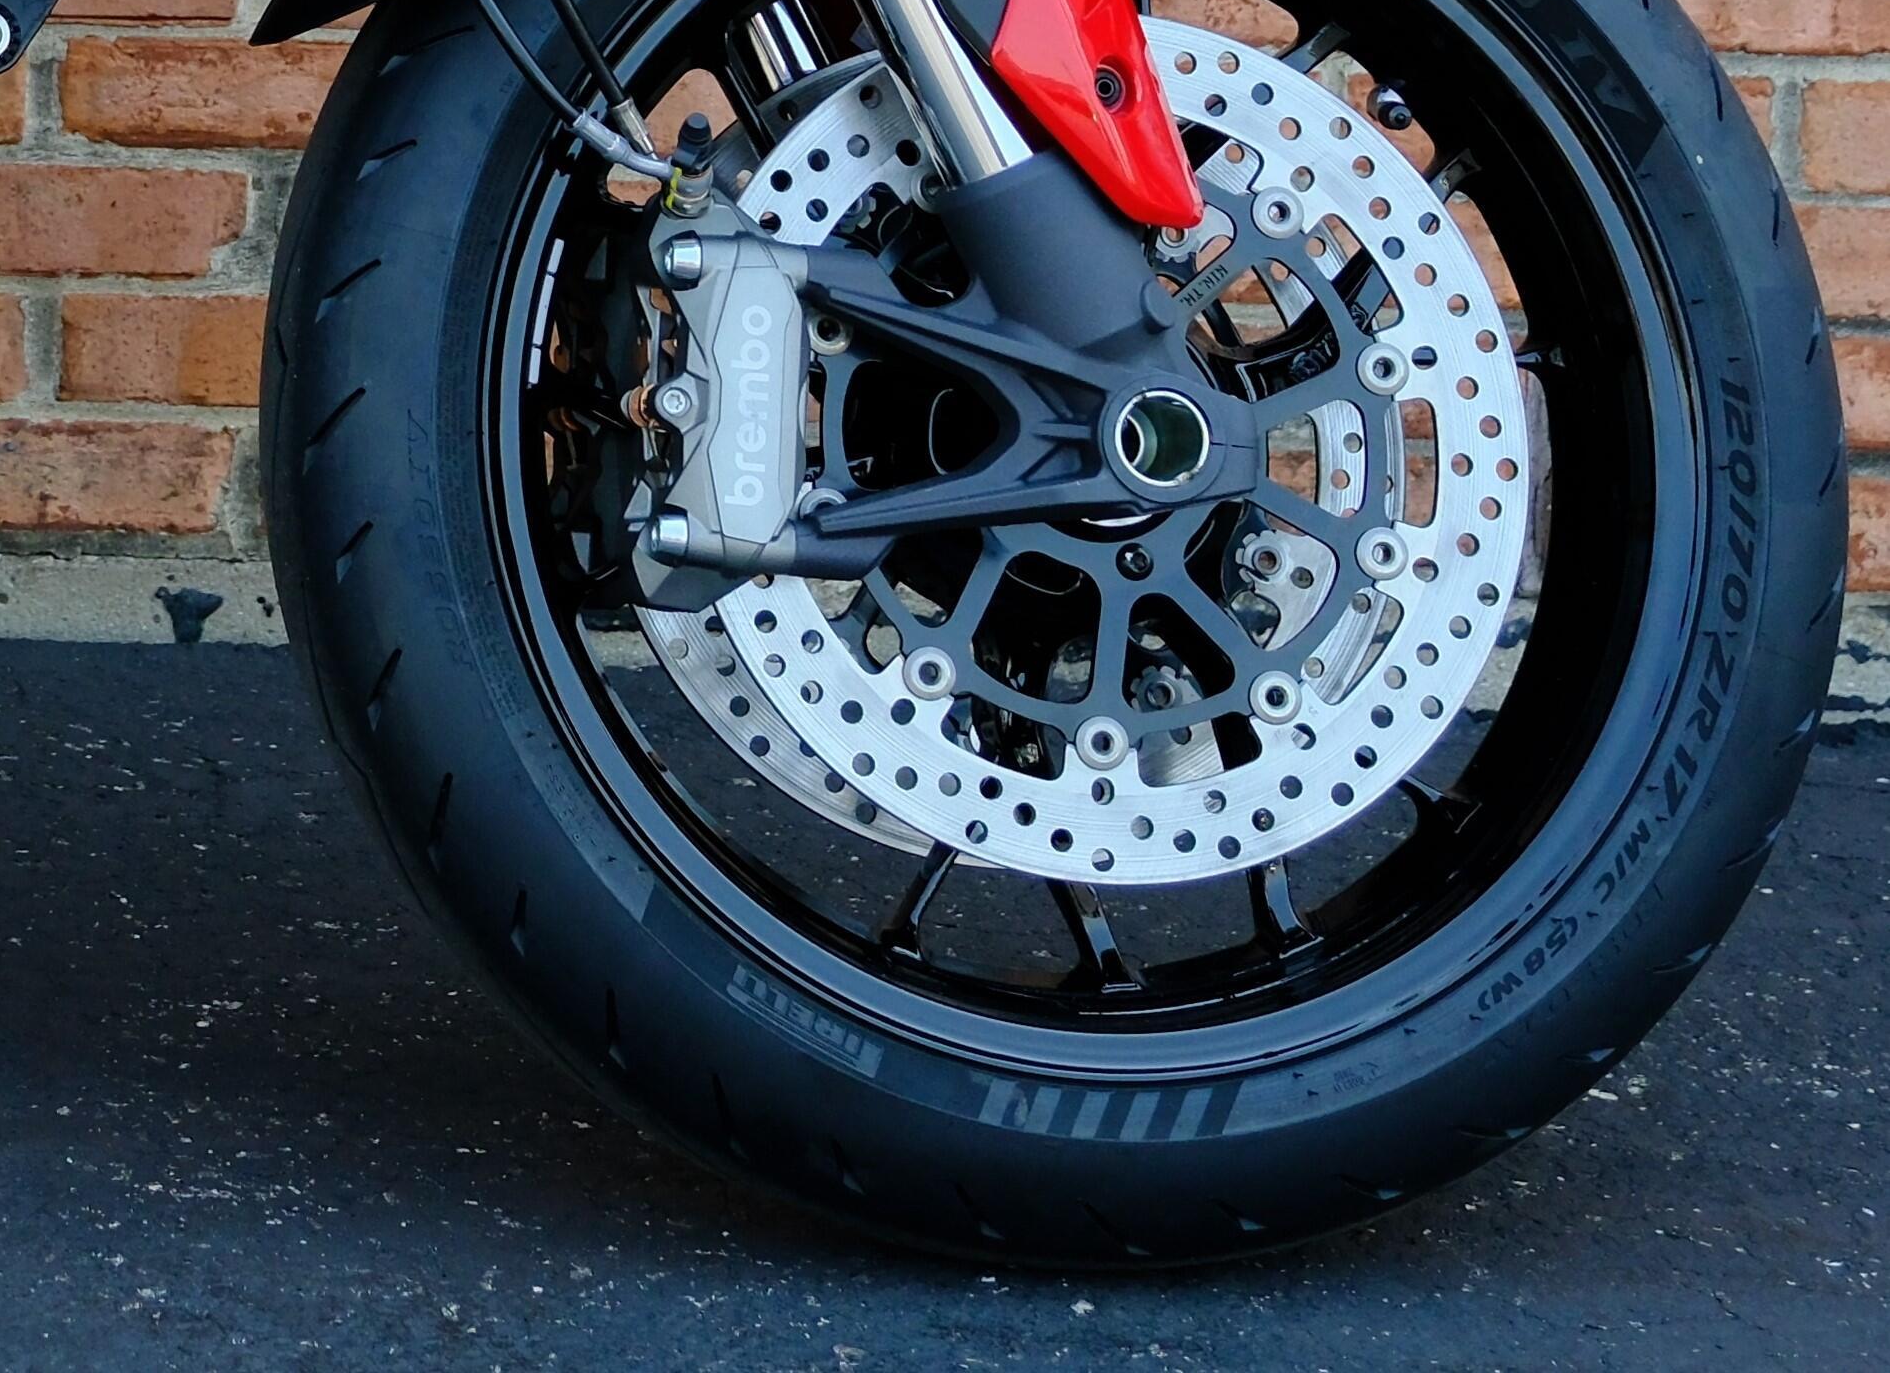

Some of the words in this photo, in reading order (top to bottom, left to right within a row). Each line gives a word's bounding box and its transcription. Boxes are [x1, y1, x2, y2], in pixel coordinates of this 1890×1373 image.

[1551, 26, 1647, 127] IV
[724, 305, 772, 507] brembo
[1718, 377, 1757, 621] 120/70
[1590, 820, 1652, 905] M/C
[726, 964, 882, 1077] PIRELLI
